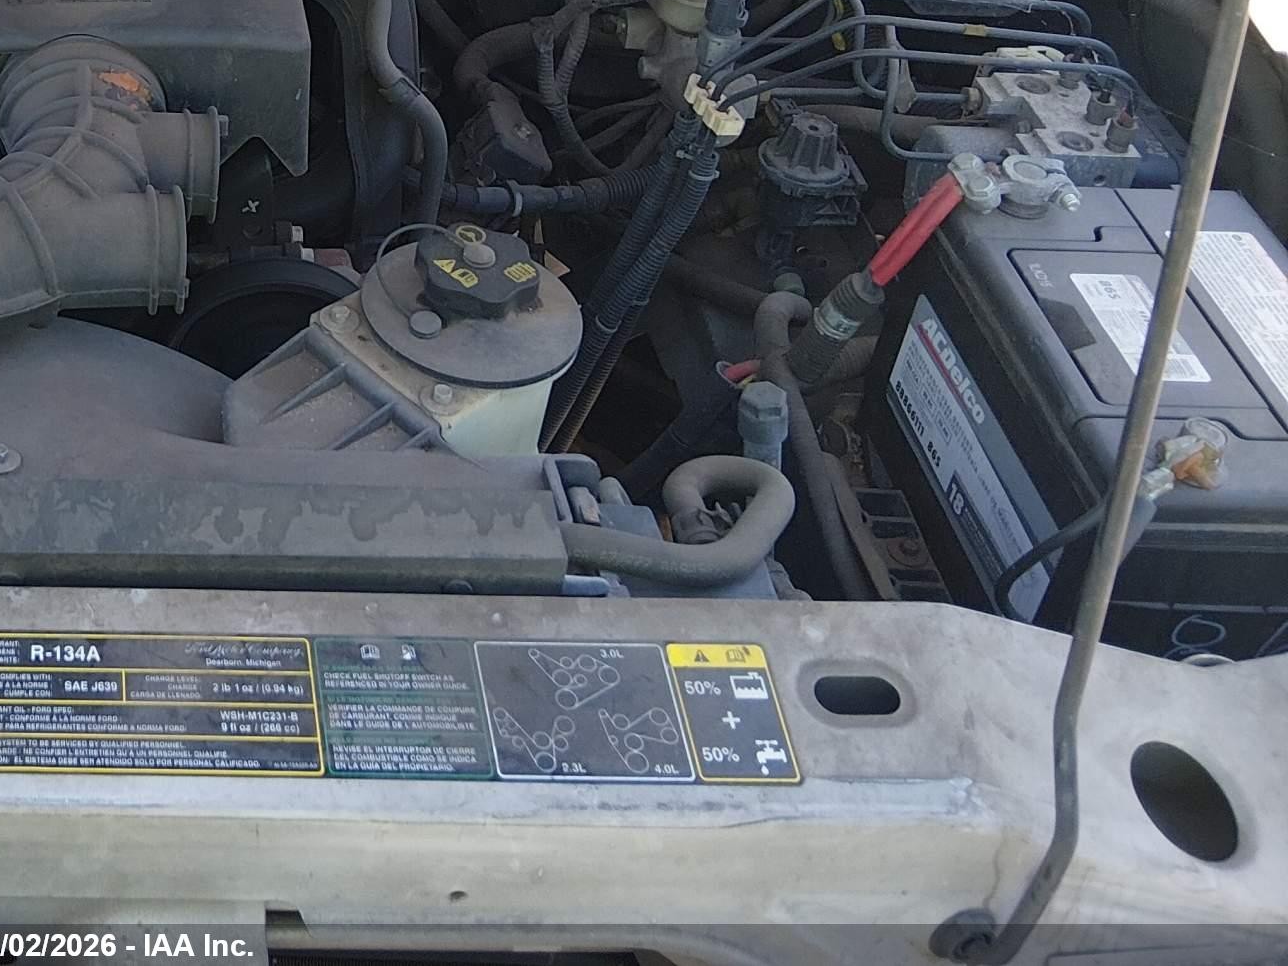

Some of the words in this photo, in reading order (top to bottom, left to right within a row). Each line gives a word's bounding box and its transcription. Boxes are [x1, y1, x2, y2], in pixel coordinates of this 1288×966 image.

[922, 318, 985, 424] ACDelco
[949, 482, 964, 515] 18
[30, 644, 100, 662] R-134A
[600, 648, 624, 658] 3.0L
[246, 658, 282, 668] Michigan
[64, 681, 88, 692] SAE
[212, 684, 219, 692] 2
[221, 683, 231, 692] lb
[684, 681, 722, 696] 50%
[702, 747, 740, 762] 50%
[654, 764, 679, 774] 4.0L
